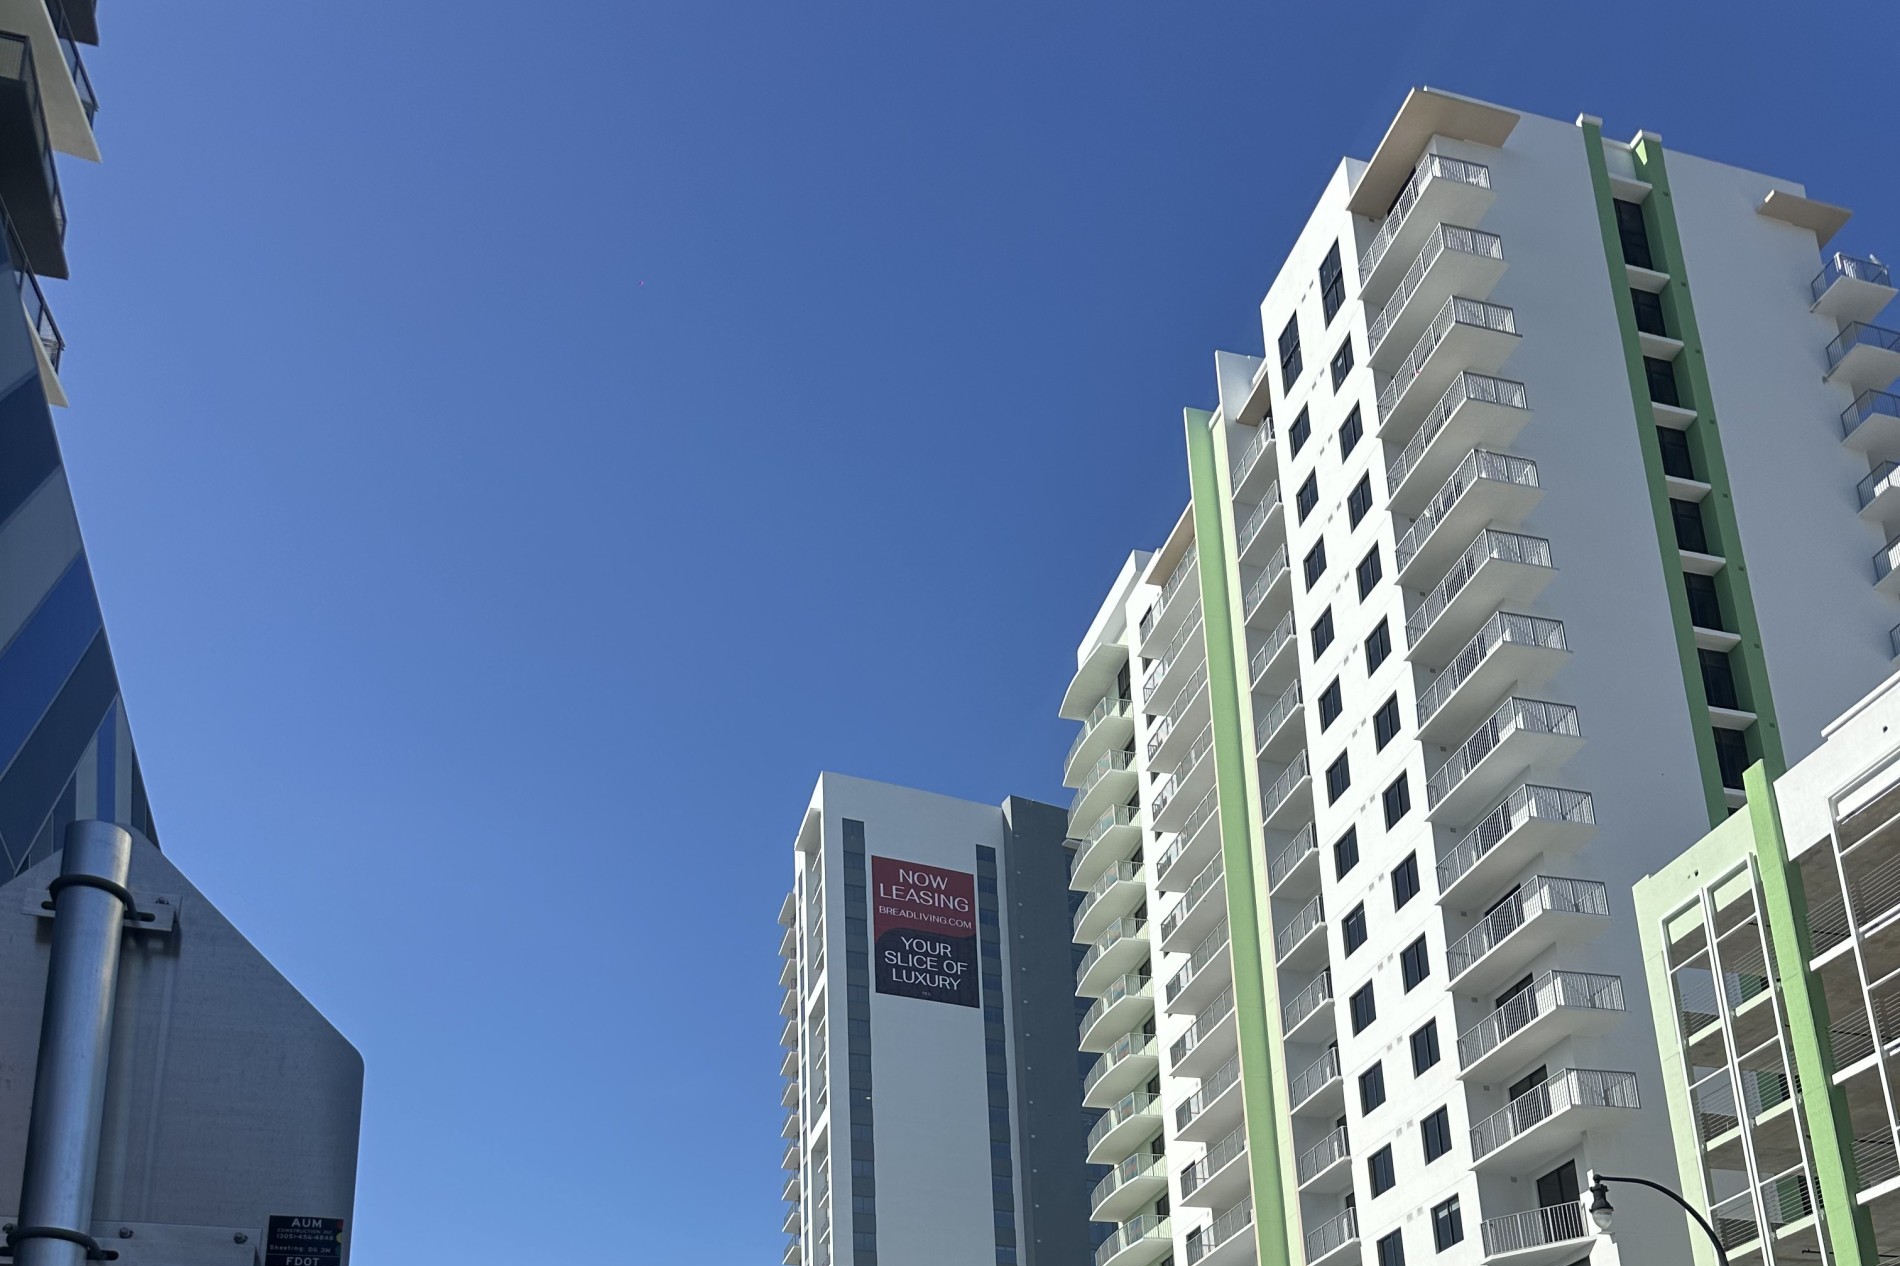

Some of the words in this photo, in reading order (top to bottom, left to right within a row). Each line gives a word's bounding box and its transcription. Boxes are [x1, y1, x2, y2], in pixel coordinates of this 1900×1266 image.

[899, 869, 948, 890] NOW
[880, 883, 969, 912] LEASING
[879, 906, 972, 929] BREADLIVING.COM
[901, 936, 952, 958] YOUR
[884, 950, 938, 972] SLICE
[943, 960, 968, 975] OF
[892, 968, 961, 990] LUXURY
[291, 1218, 322, 1228] AUM
[286, 1256, 320, 1266] FDOT
